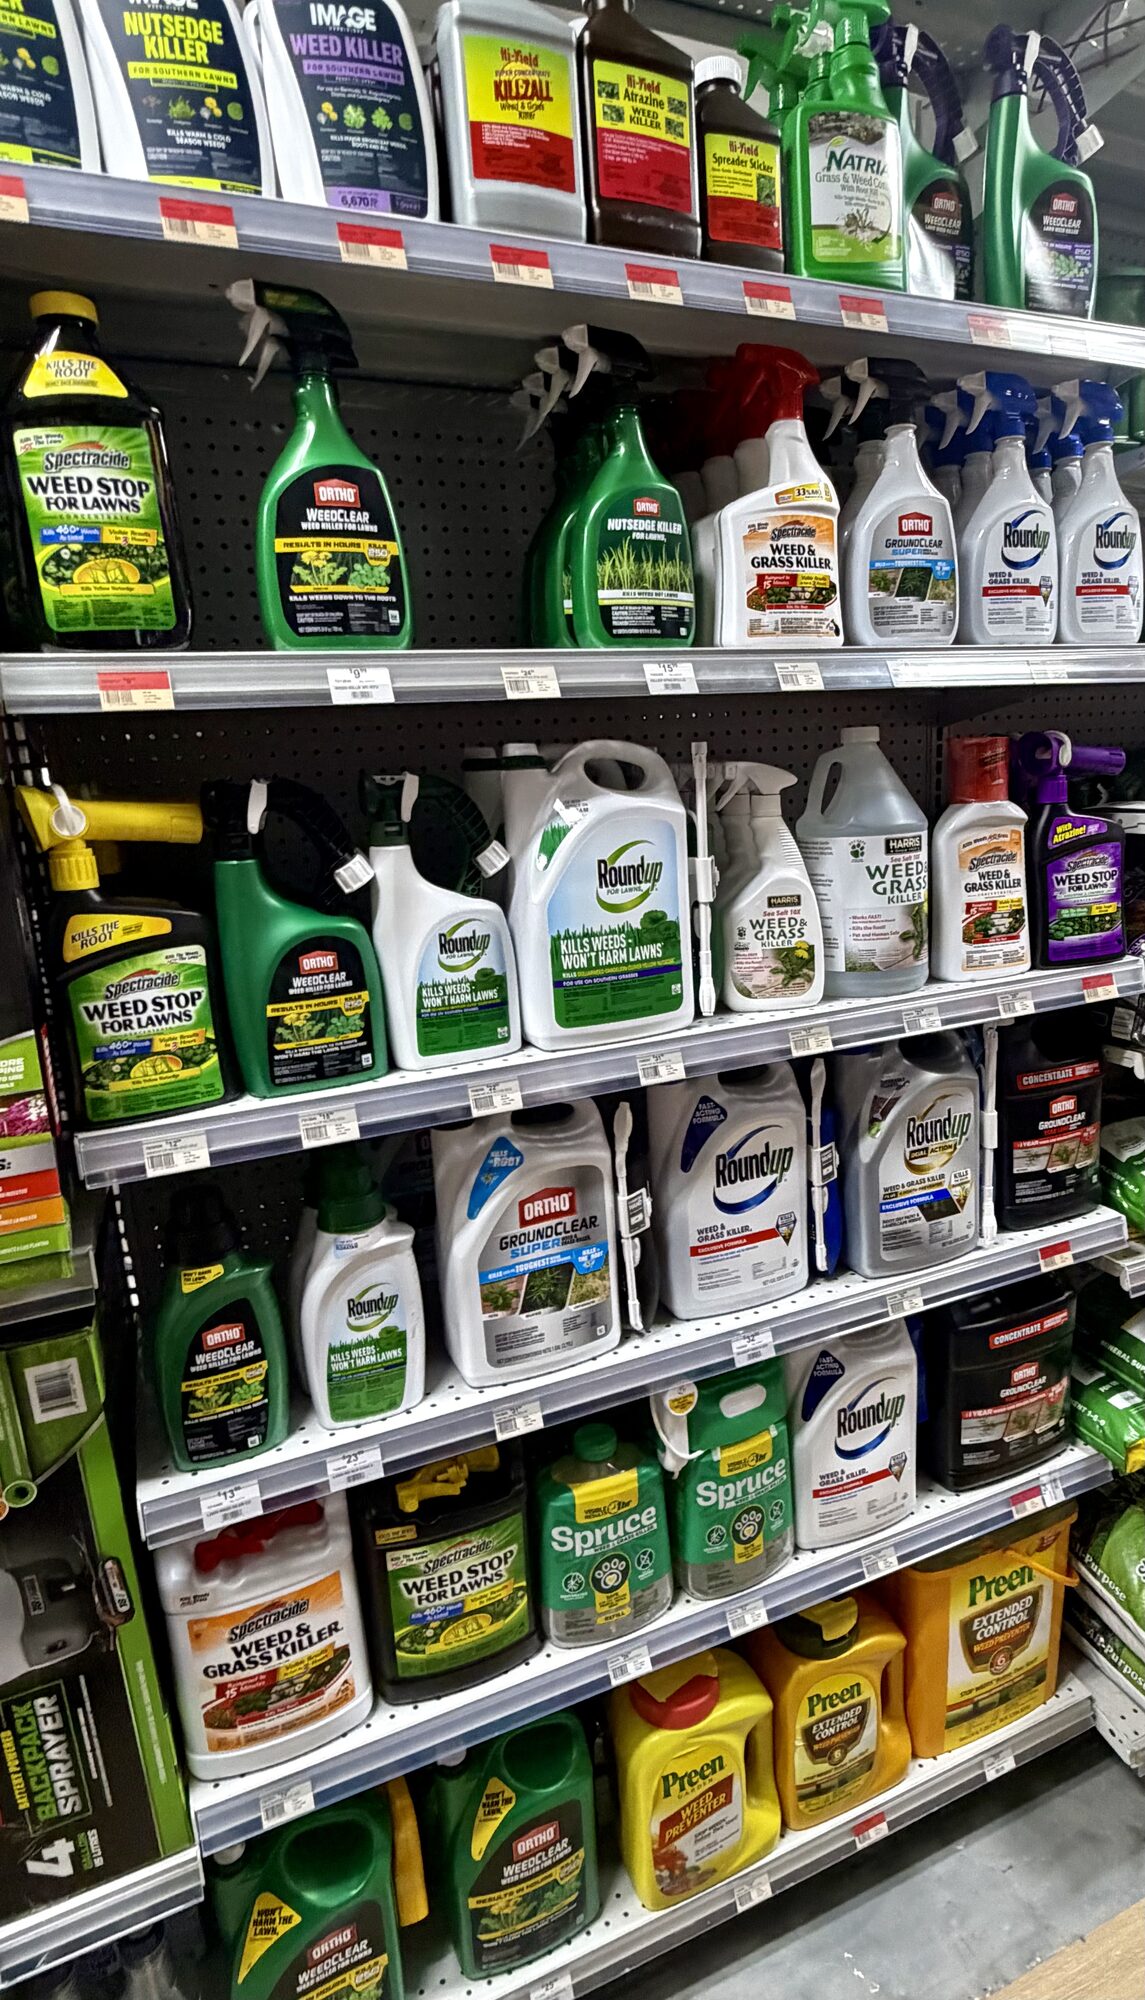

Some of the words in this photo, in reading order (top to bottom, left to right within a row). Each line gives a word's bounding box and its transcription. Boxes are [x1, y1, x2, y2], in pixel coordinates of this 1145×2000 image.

[309, 3, 376, 32] IMAGE
[123, 12, 224, 45] NUTSEDGE
[144, 36, 209, 64] KILLER
[290, 34, 340, 56] WEED
[346, 36, 403, 66] KILLER
[154, 67, 202, 80] SOUTHERN
[204, 72, 235, 86] LAWNS
[306, 64, 324, 72] FOR
[326, 64, 370, 76] SOUTHERN
[624, 89, 664, 110] Atrazine
[631, 106, 658, 120] WEED
[729, 141, 758, 156] Hi-Yield
[712, 152, 748, 168] Spreader
[750, 157, 774, 174] Sticker
[815, 172, 842, 184] Grass
[843, 172, 850, 183] &
[851, 174, 873, 185] Weed
[341, 195, 370, 208] 6,670
[934, 198, 956, 212] ORTHO
[1053, 198, 1075, 212] ORTHO
[27, 476, 93, 495] WEED
[97, 478, 150, 498] STOP
[319, 486, 355, 503] ORTHO
[46, 497, 80, 510] FOR
[83, 498, 141, 513] LAWNS
[636, 502, 658, 513] ORTHO
[301, 522, 320, 531] WEED
[321, 522, 343, 531] KILLER
[344, 523, 355, 532] FOR
[357, 524, 378, 533] LAWNS
[607, 518, 654, 533] NUTSEDGE
[656, 522, 682, 535] KILLER
[902, 519, 929, 532] ORTHO
[632, 532, 644, 540] FOR
[1004, 522, 1050, 550] Roundup
[1096, 524, 1137, 552] Roundup
[770, 543, 806, 556] WEED
[807, 544, 816, 556] &
[892, 548, 922, 556] SUPER
[751, 556, 794, 569] GRASS
[795, 556, 832, 570] KILLER
[763, 580, 771, 589] 15
[890, 836, 920, 848] HARRIS
[964, 881, 994, 893] GRASS
[995, 878, 1021, 891] KILLER
[1055, 873, 1089, 886] WEED
[1092, 870, 1118, 883] STOP
[606, 888, 619, 896] FOR
[620, 886, 642, 894] LAWNS
[887, 892, 922, 904] KILLER
[750, 918, 798, 930] WEED
[800, 918, 808, 926] &
[438, 932, 490, 955] Roundup
[560, 936, 592, 952] KILLS
[594, 934, 626, 950] WEEDS
[754, 928, 805, 941] GRASS
[761, 940, 792, 948] KILLER
[303, 956, 334, 971] ORTHO
[561, 952, 598, 969] WON'T
[599, 948, 627, 965] HARM
[629, 943, 662, 960] LAWNS
[104, 972, 179, 1000] Spectracide
[288, 986, 304, 995] WEED
[306, 985, 322, 993] KILLER
[422, 985, 443, 997] KILLS
[445, 983, 470, 995] WEEDS
[82, 999, 148, 1022] WEED
[151, 990, 203, 1012] STOP
[271, 1005, 304, 1014] RESULTS
[315, 1000, 338, 1008] HOURS
[159, 1036, 176, 1044] Visible
[179, 1032, 199, 1041] Results
[0, 1058, 24, 1067] ORE
[1022, 1068, 1073, 1086] CONCENTRATE
[1052, 1102, 1075, 1114] ORTHO
[907, 1108, 972, 1150] Roundup
[910, 1149, 927, 1159] DUAL
[930, 1144, 953, 1154] ACTION
[715, 1142, 793, 1188] Roundup
[523, 1195, 571, 1220] ORTHO
[697, 1226, 718, 1238] WEED
[720, 1223, 726, 1232] &
[510, 1239, 560, 1258] SUPER
[347, 1294, 398, 1318] Roundup
[206, 1328, 240, 1347] ORTHO
[994, 1323, 1041, 1345] CONCENTRATE
[1014, 1367, 1035, 1381] ORTHO
[837, 1392, 905, 1438] Roundup
[696, 1458, 786, 1510] Spruce
[819, 1471, 839, 1482] WEED
[584, 1506, 606, 1515] VISIBLE
[551, 1506, 657, 1557] Spruce
[423, 1540, 492, 1576] Spectracide
[402, 1568, 464, 1598] WEED
[466, 1549, 515, 1579] STOP
[417, 1588, 449, 1605] FOR
[452, 1572, 503, 1597] LAWNS
[968, 1566, 1033, 1608] Preen
[228, 1600, 310, 1643] Spectracide
[605, 1611, 625, 1621] REFILL
[972, 1595, 1033, 1630] EXTENDED
[203, 1654, 276, 1679] GRASS
[277, 1621, 340, 1660] KILLER
[807, 1682, 862, 1718] Preen
[812, 1706, 862, 1734] EXTENDED
[814, 1718, 860, 1741] CONTROL
[11, 1701, 58, 1820] BACKPACK
[33, 1694, 82, 1817] SPRAYER
[661, 1755, 725, 1799] Preen
[482, 1800, 500, 1808] HARM
[501, 1797, 513, 1805] THE
[665, 1794, 726, 1841] PREVENTER
[517, 1829, 558, 1855] ORTHO
[26, 1838, 75, 1878] 4
[476, 1891, 515, 1905] RESULTS
[257, 1906, 283, 1918] WON'T
[312, 1932, 352, 1960] ORTHO
